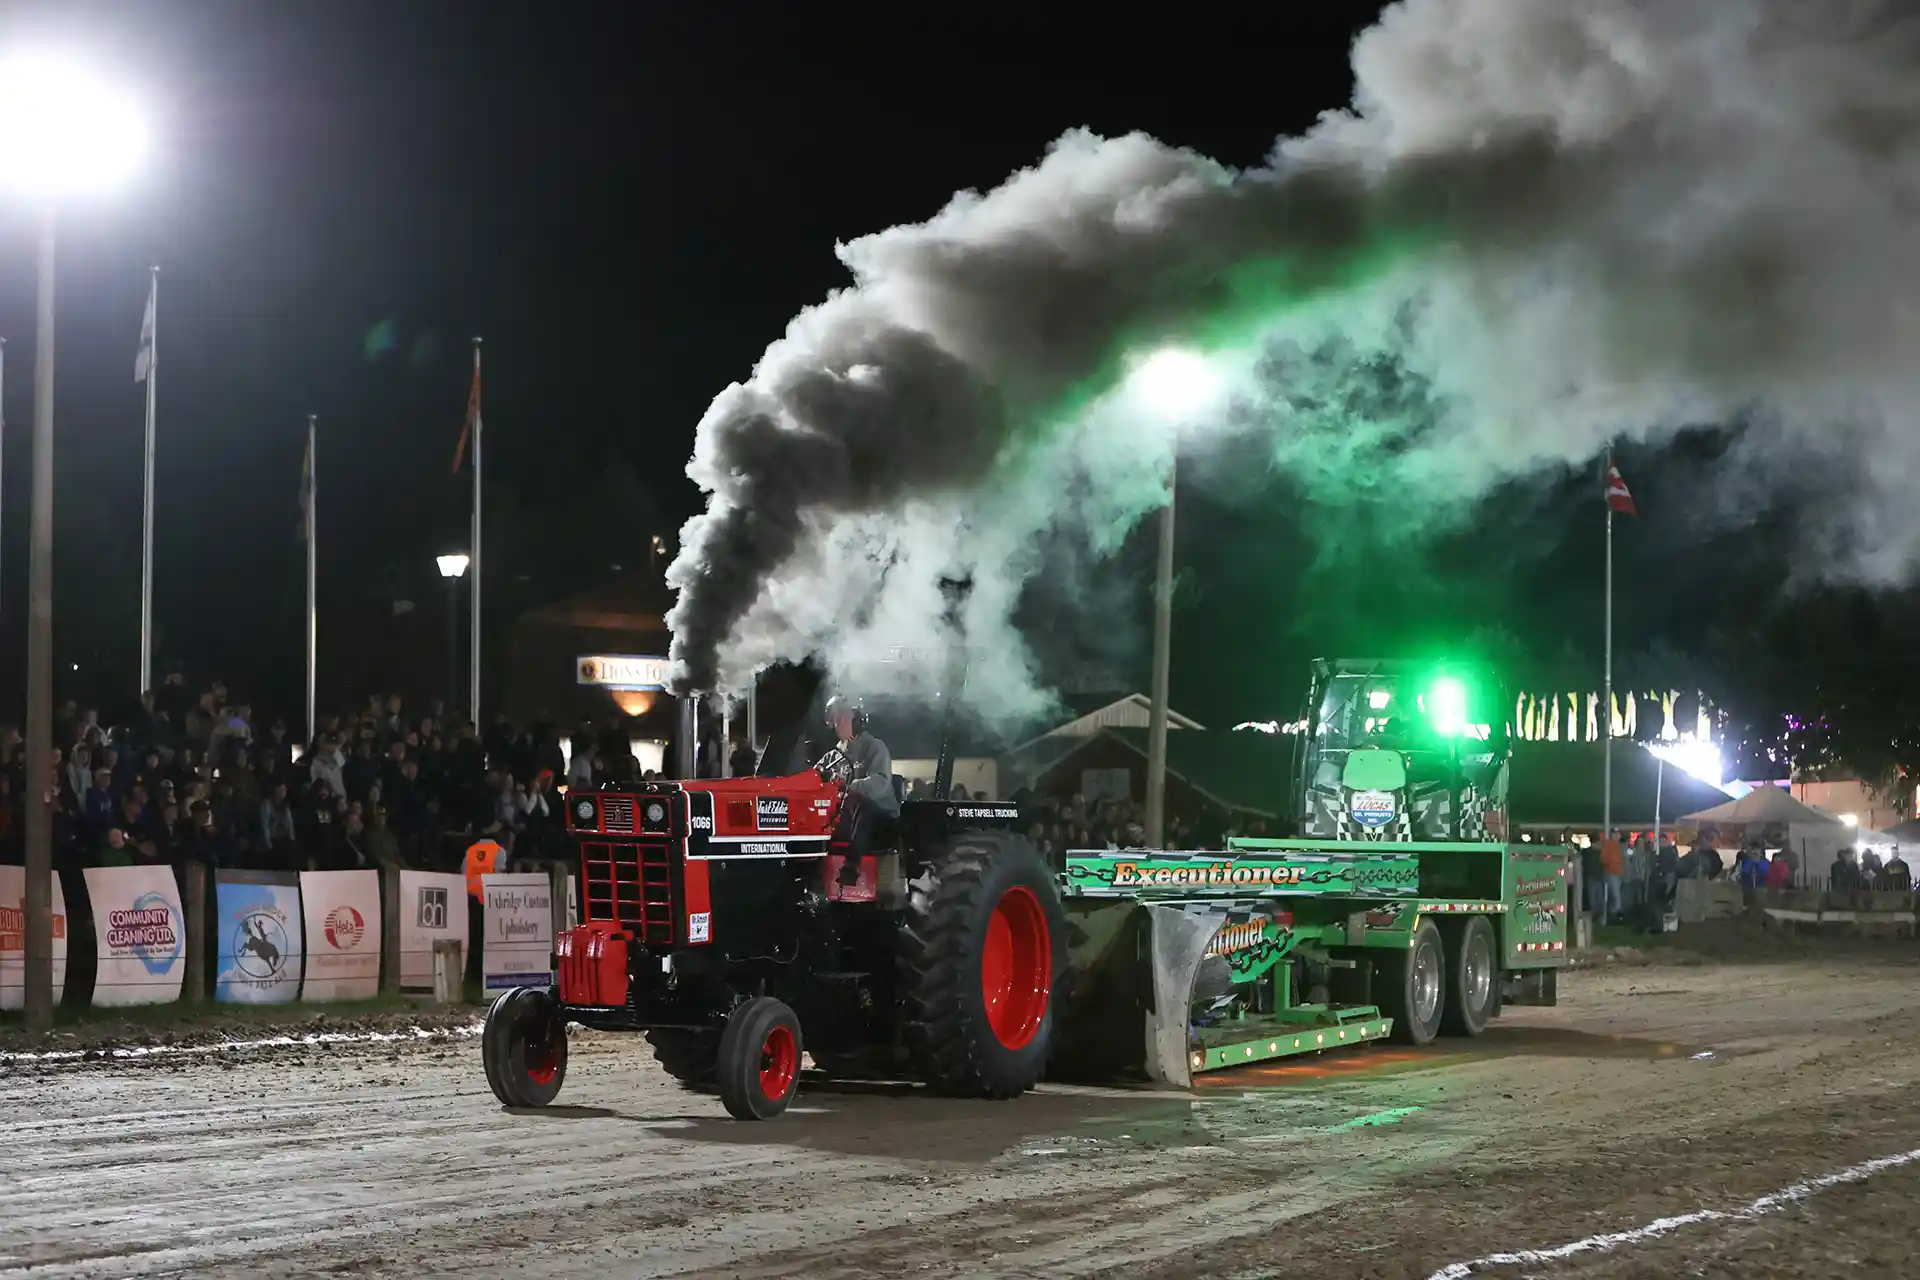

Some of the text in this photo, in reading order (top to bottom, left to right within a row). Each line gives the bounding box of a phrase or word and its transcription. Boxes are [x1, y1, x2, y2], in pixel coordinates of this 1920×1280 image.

[959, 808, 1018, 818] STEVE TAPSELL TRUCKING
[1357, 801, 1391, 810] LUCAS
[691, 816, 711, 829] 1066
[740, 843, 788, 854] INTERNATIONAL
[1113, 861, 1306, 886] Executioner
[110, 909, 169, 928] COMMUNITY
[108, 927, 176, 946] CLEANING LTD.
[499, 918, 538, 941] Upholstery
